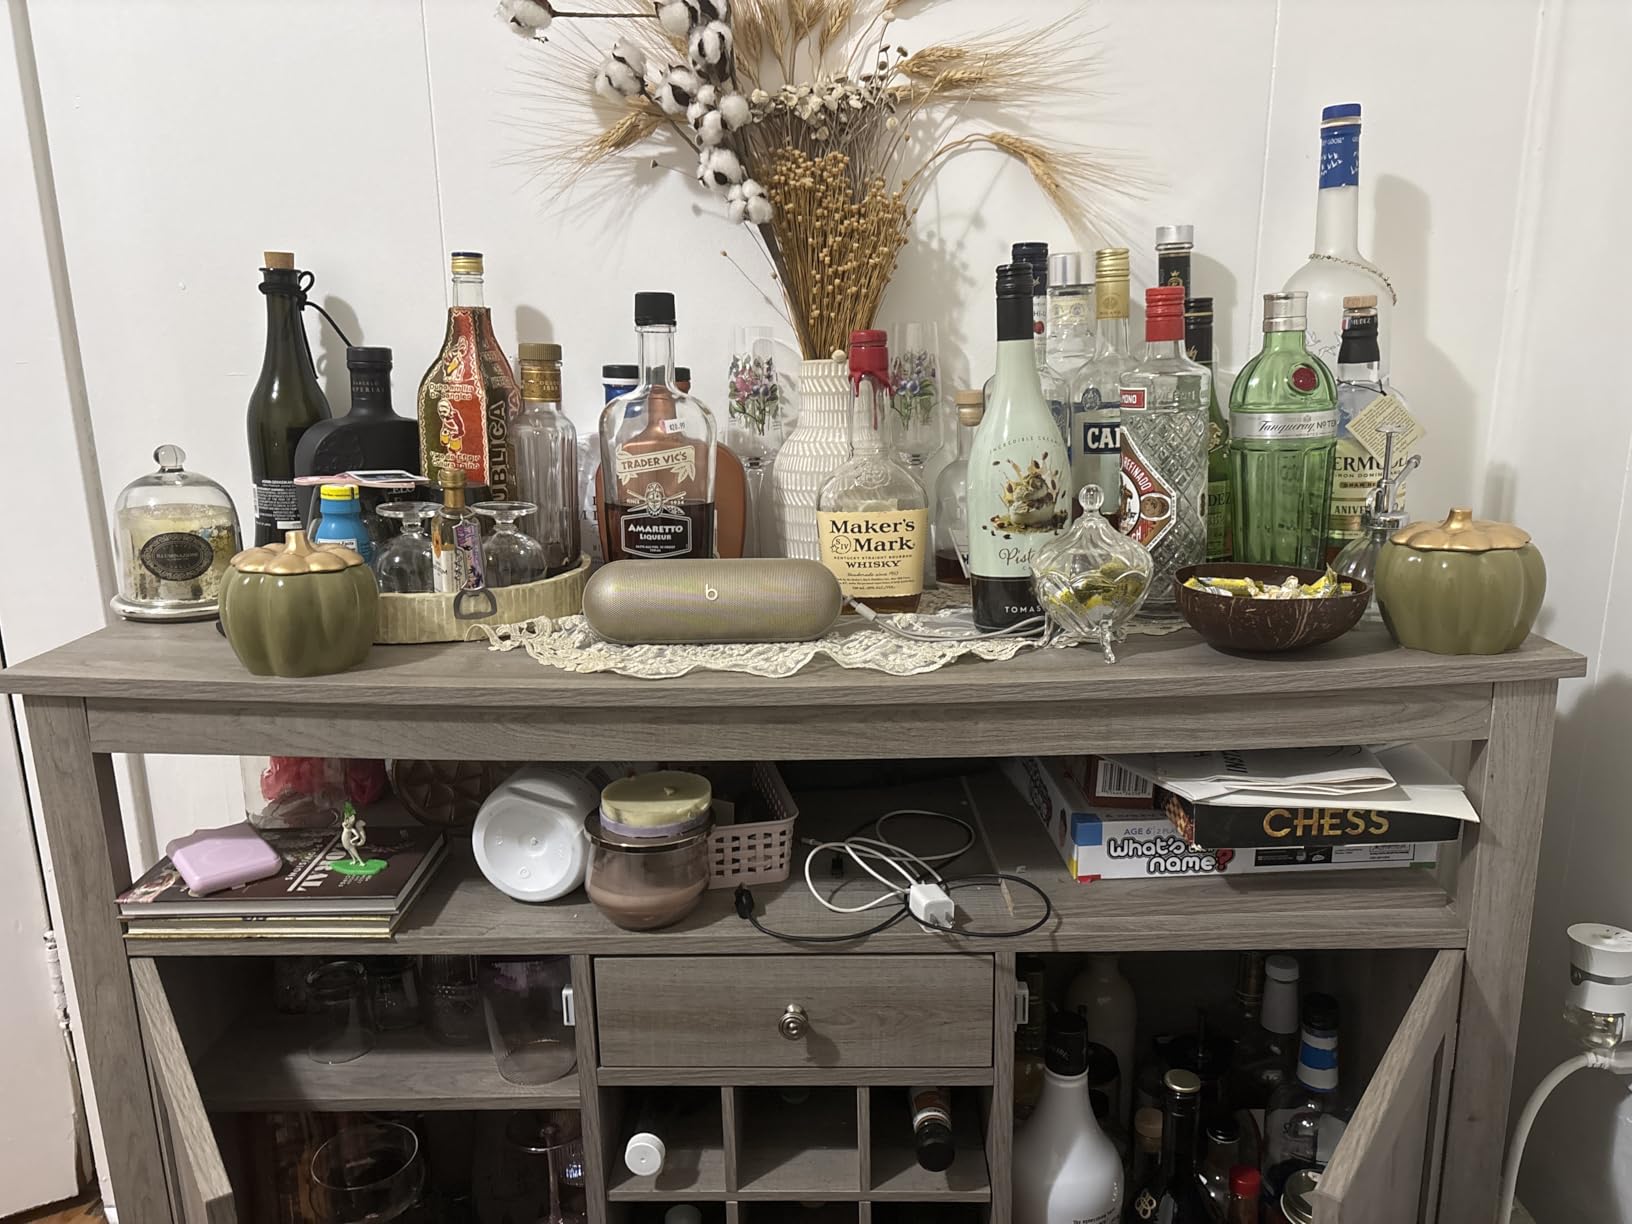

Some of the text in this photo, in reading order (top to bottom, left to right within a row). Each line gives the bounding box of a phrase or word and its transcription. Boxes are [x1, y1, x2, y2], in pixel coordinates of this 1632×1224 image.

[1259, 420, 1315, 434] Tanqueray
[1087, 426, 1120, 450] CA
[488, 400, 508, 500] UBLICA
[621, 450, 688, 471] TRADER VIC'S
[628, 523, 683, 533] AMARETTO
[829, 519, 915, 534] Maker's
[852, 536, 913, 552] Mark
[846, 560, 902, 569] WHISKY
[1004, 606, 1042, 614] TOMAS
[1262, 807, 1390, 838] CHESS
[1123, 828, 1143, 836] AGE
[1108, 836, 1186, 858] What's
